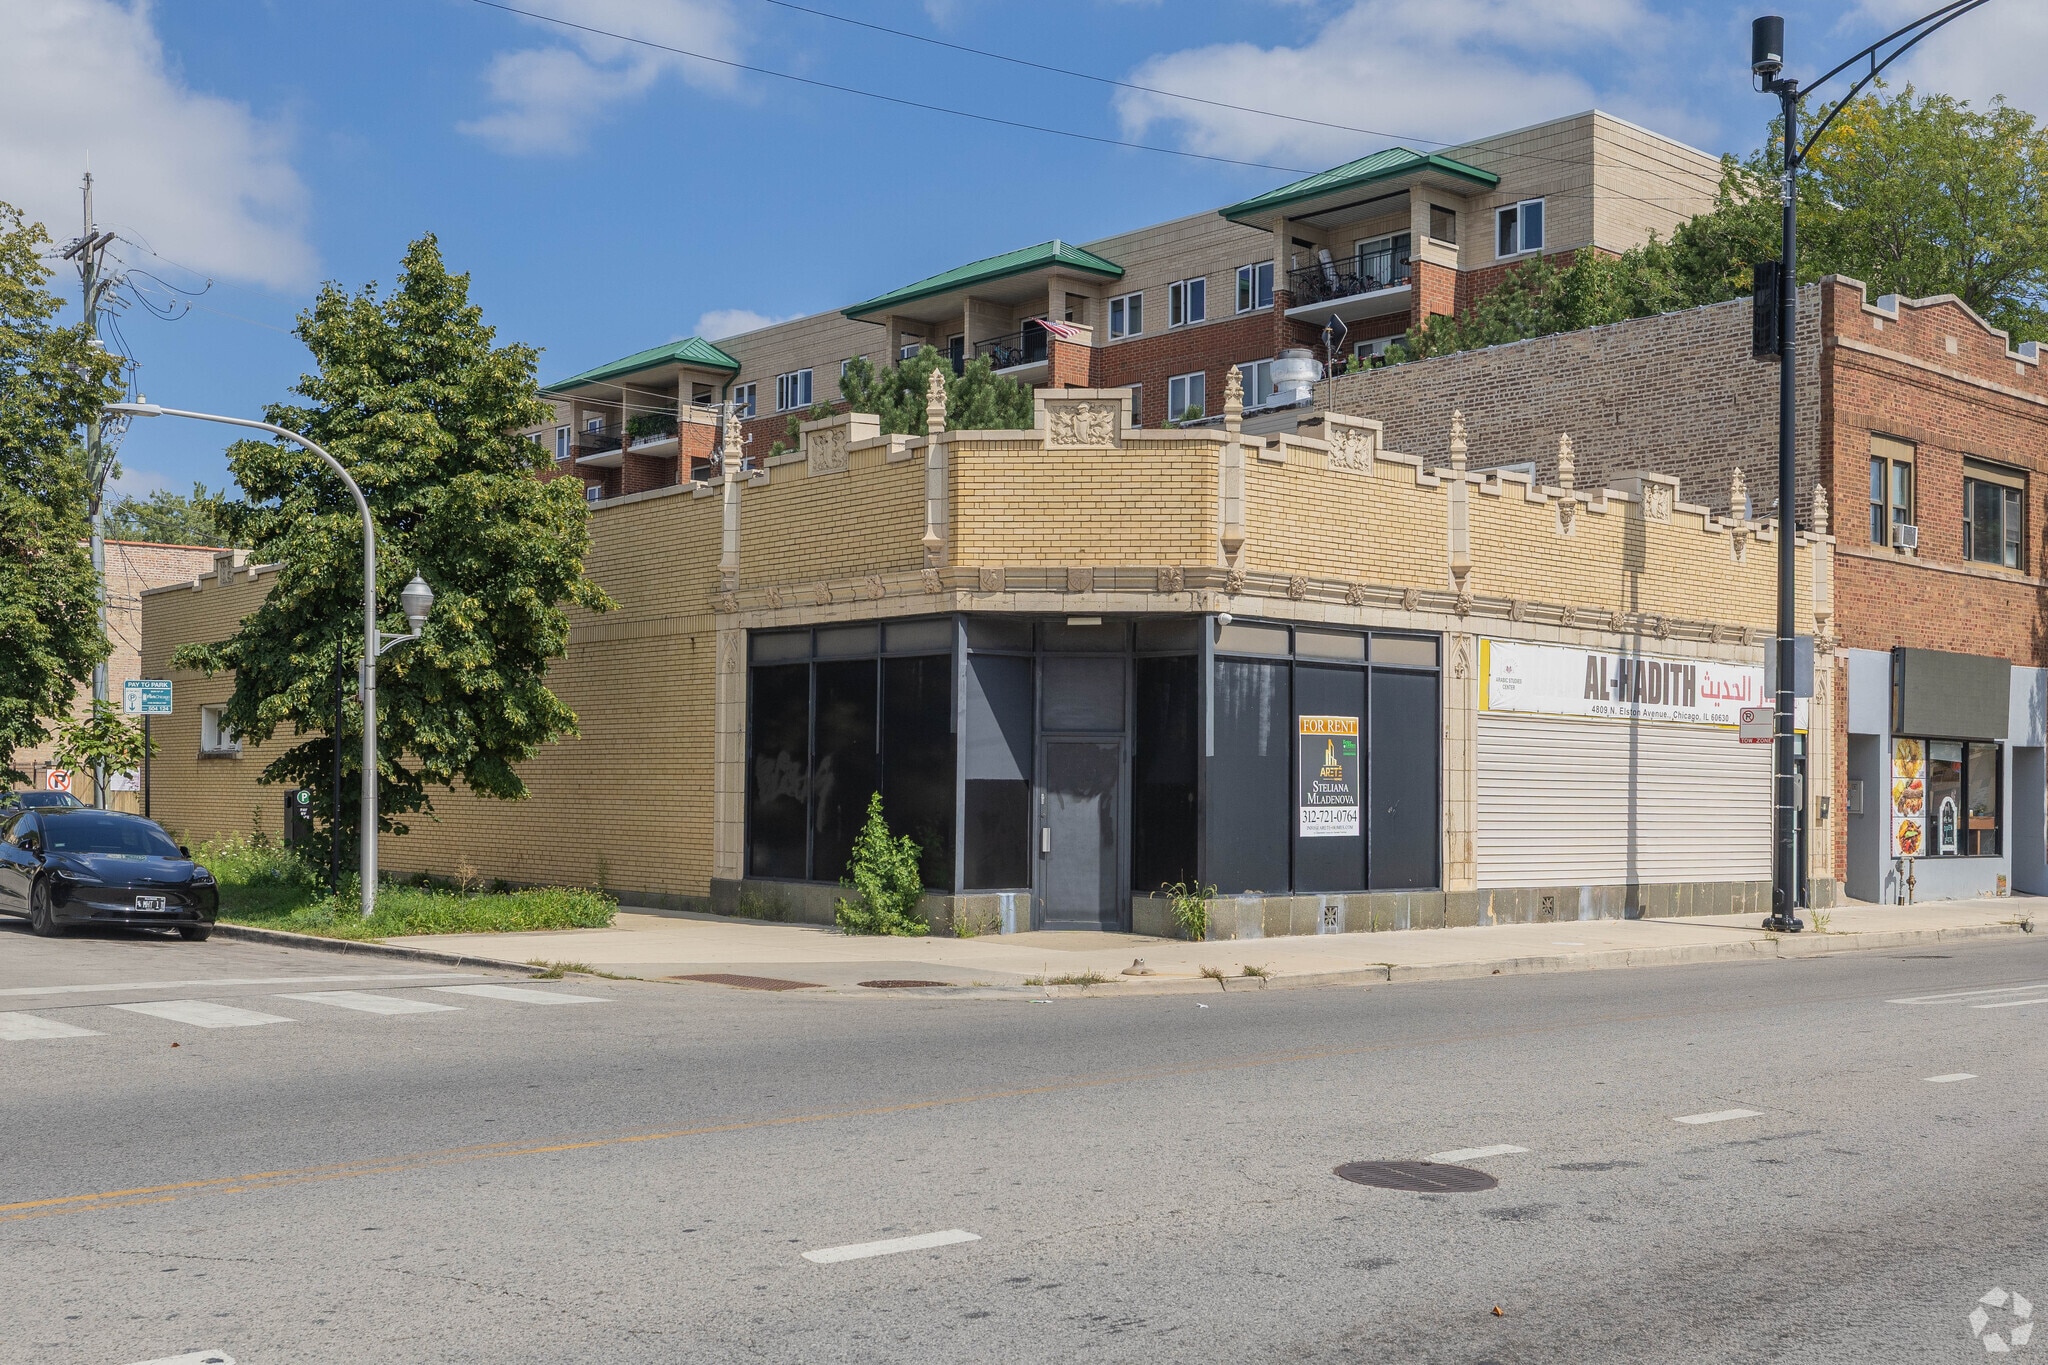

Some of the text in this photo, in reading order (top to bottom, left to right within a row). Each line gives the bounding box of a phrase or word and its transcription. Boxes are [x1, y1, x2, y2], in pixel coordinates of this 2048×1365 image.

[1584, 655, 1696, 707] AL-HADITH
[1701, 671, 1751, 707] الحديث
[1591, 705, 1608, 714] 4809
[1610, 707, 1617, 715] N.
[1620, 708, 1640, 717] Elston
[1703, 713, 1710, 721] IL
[1711, 713, 1729, 722] 60630
[1303, 719, 1355, 733] FOR RENT
[1302, 809, 1357, 823] 312-721-0764
